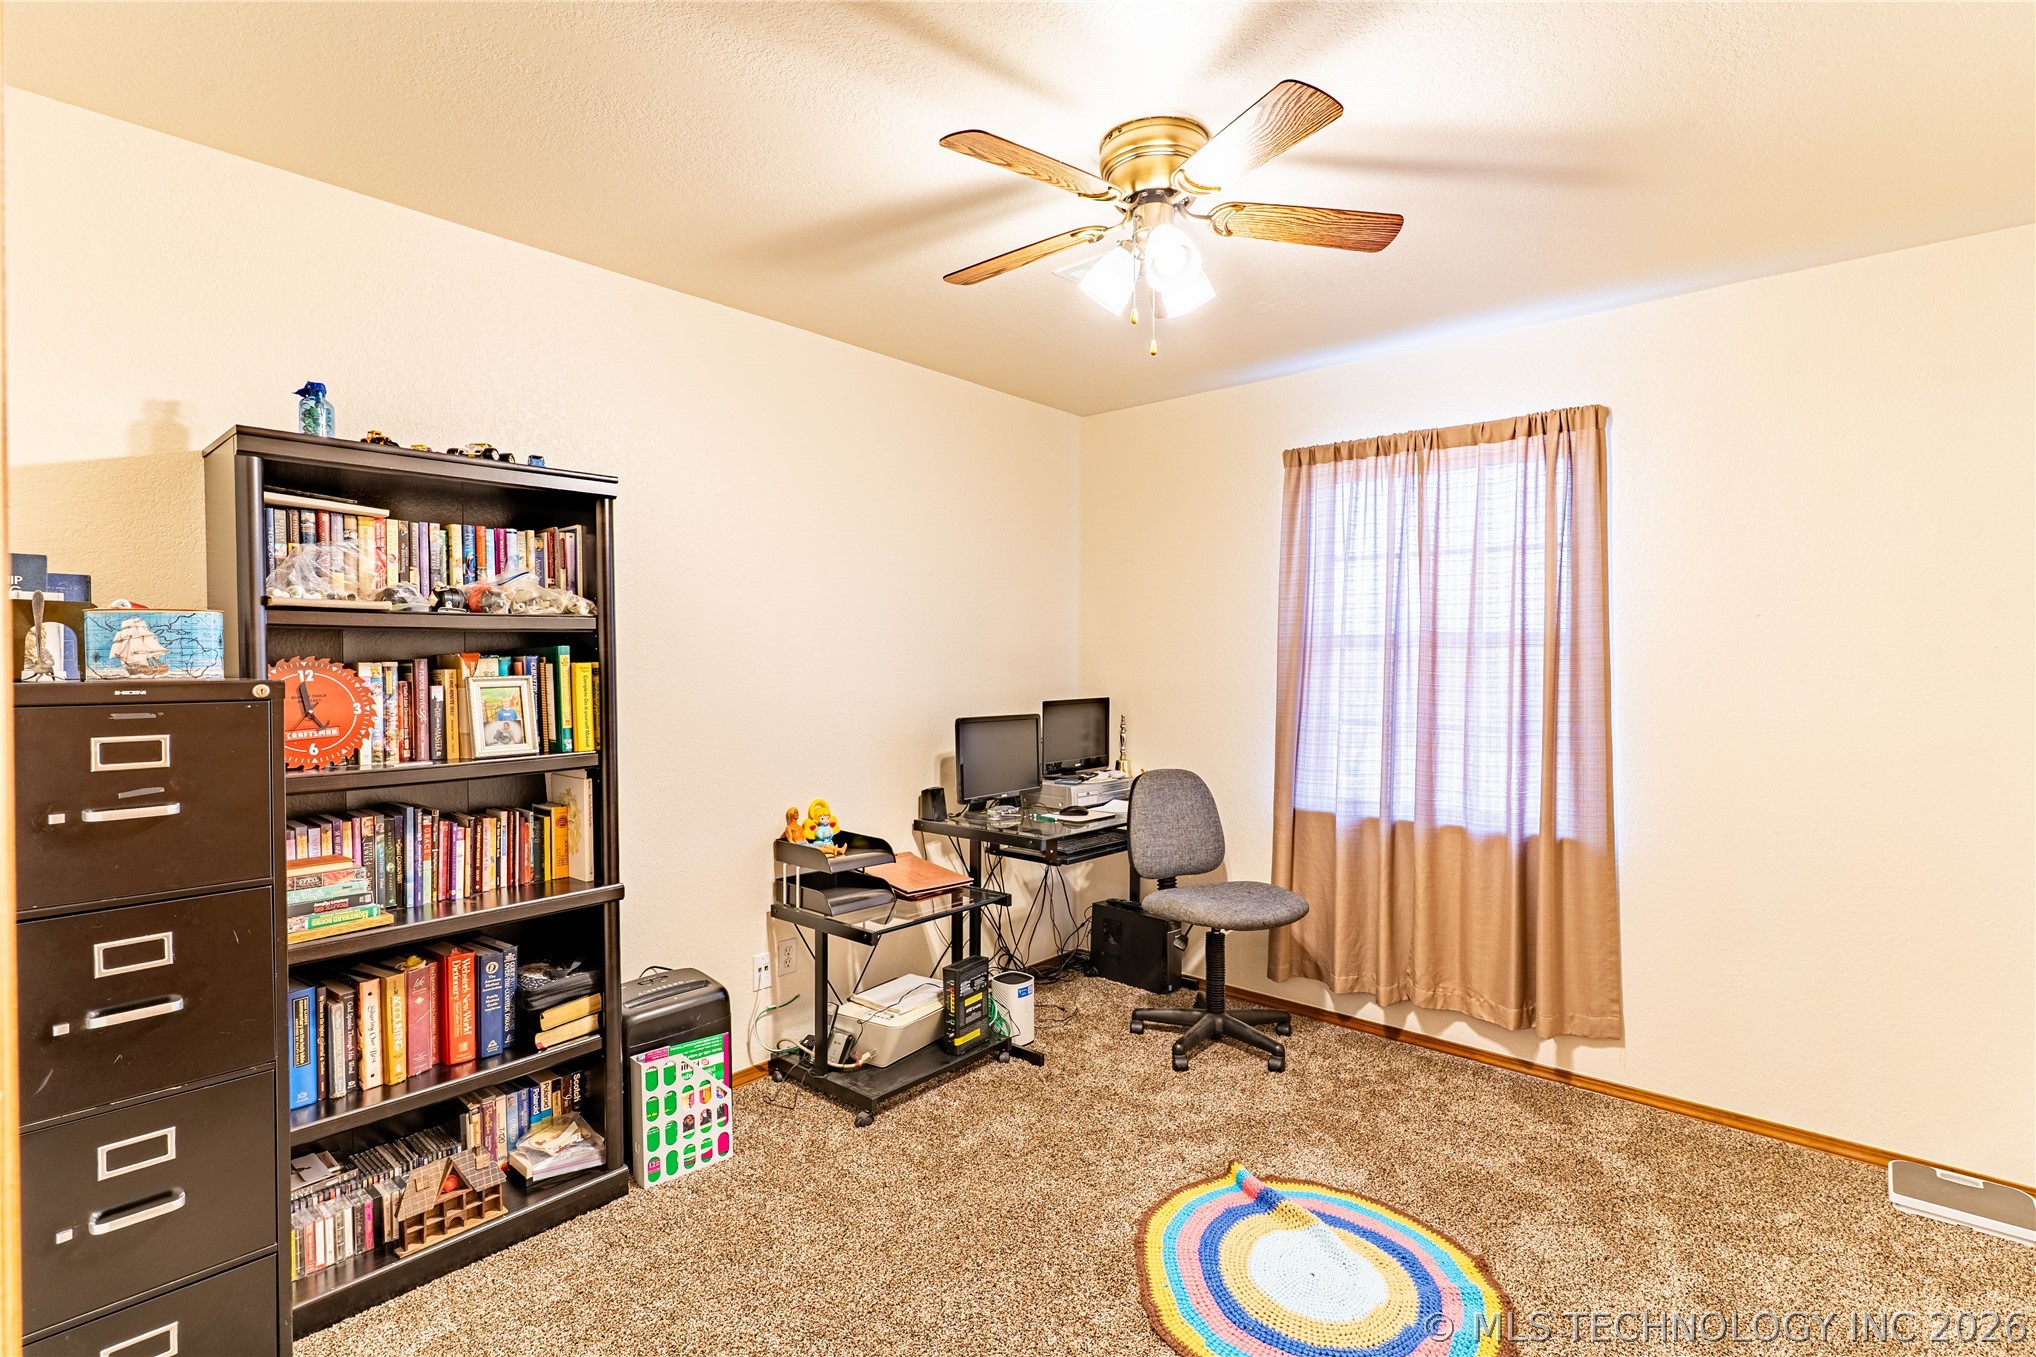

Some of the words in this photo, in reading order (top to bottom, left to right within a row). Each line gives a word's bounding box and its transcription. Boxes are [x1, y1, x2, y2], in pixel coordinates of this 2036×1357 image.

[297, 669, 314, 682] 12
[352, 702, 362, 715] 3
[287, 728, 338, 740] CRAFTSMAN
[434, 728, 443, 751] MASTER
[309, 743, 319, 756] 6
[324, 902, 349, 911] ROUTE
[332, 910, 369, 923] HOMEWARD
[451, 960, 461, 1001] Dictionary
[461, 957, 471, 994] Webster's
[346, 1001, 354, 1013] God
[462, 993, 471, 1012] New
[346, 1012, 354, 1030] Speaks
[367, 1005, 376, 1032] Sharing
[393, 995, 403, 1051] ACCOUNTING
[462, 1011, 472, 1035] World
[346, 1030, 354, 1051] Through
[369, 1031, 377, 1045] Our
[542, 1082, 550, 1109] Polaroid
[573, 1073, 581, 1102] Scotch
[532, 1088, 541, 1115] Polaroid
[497, 1127, 506, 1144] T-120
